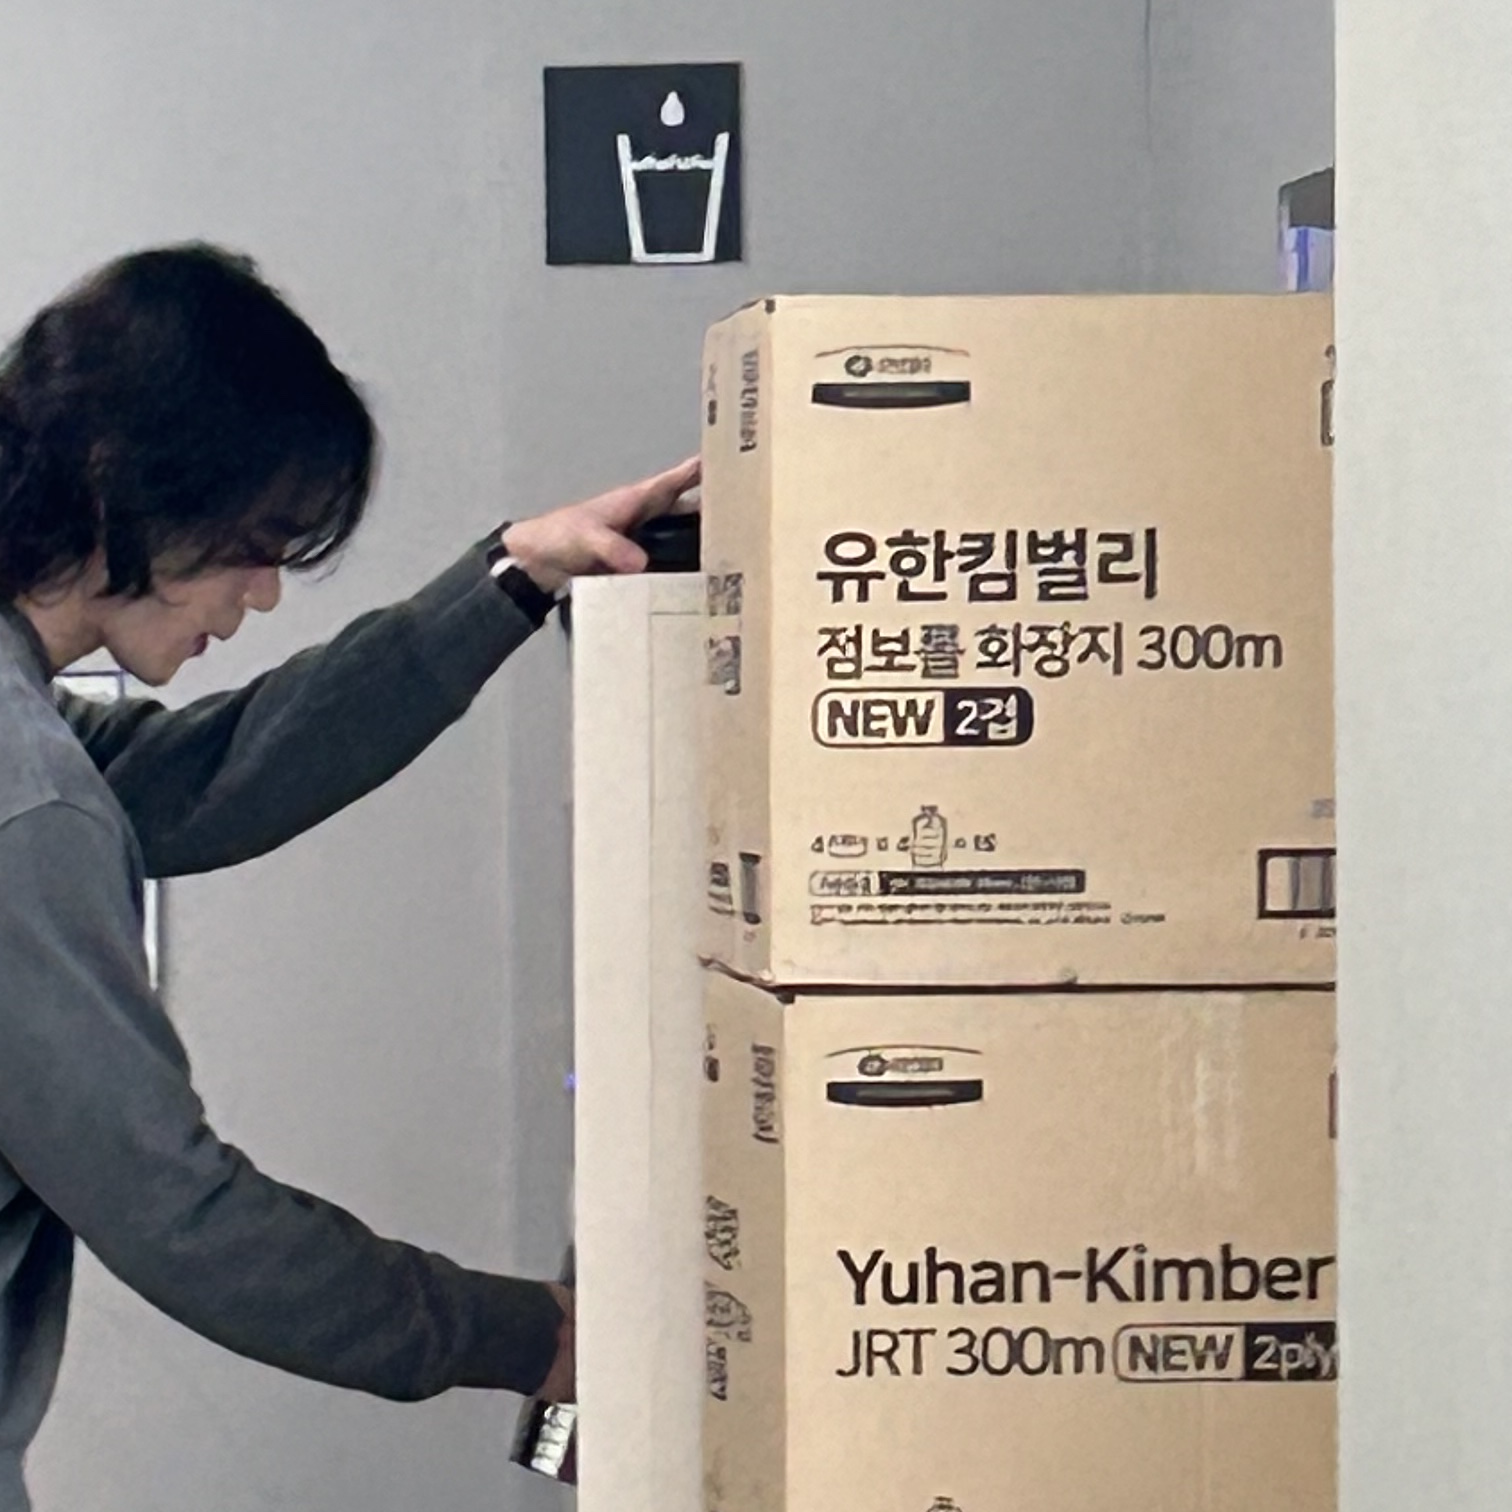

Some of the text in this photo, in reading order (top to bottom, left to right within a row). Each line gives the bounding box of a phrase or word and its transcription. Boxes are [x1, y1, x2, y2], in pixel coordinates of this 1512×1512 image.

[816, 527, 1158, 602] 유한킴벌리
[974, 620, 1124, 679] 화장지
[1136, 623, 1284, 670] 300m
[826, 692, 1018, 740] NEW 2겹
[836, 1244, 1336, 1306] Yuhan-Kimber
[835, 1327, 937, 1378] JRT
[946, 1326, 1105, 1378] 300m
[1127, 1333, 1235, 1377] NEW
